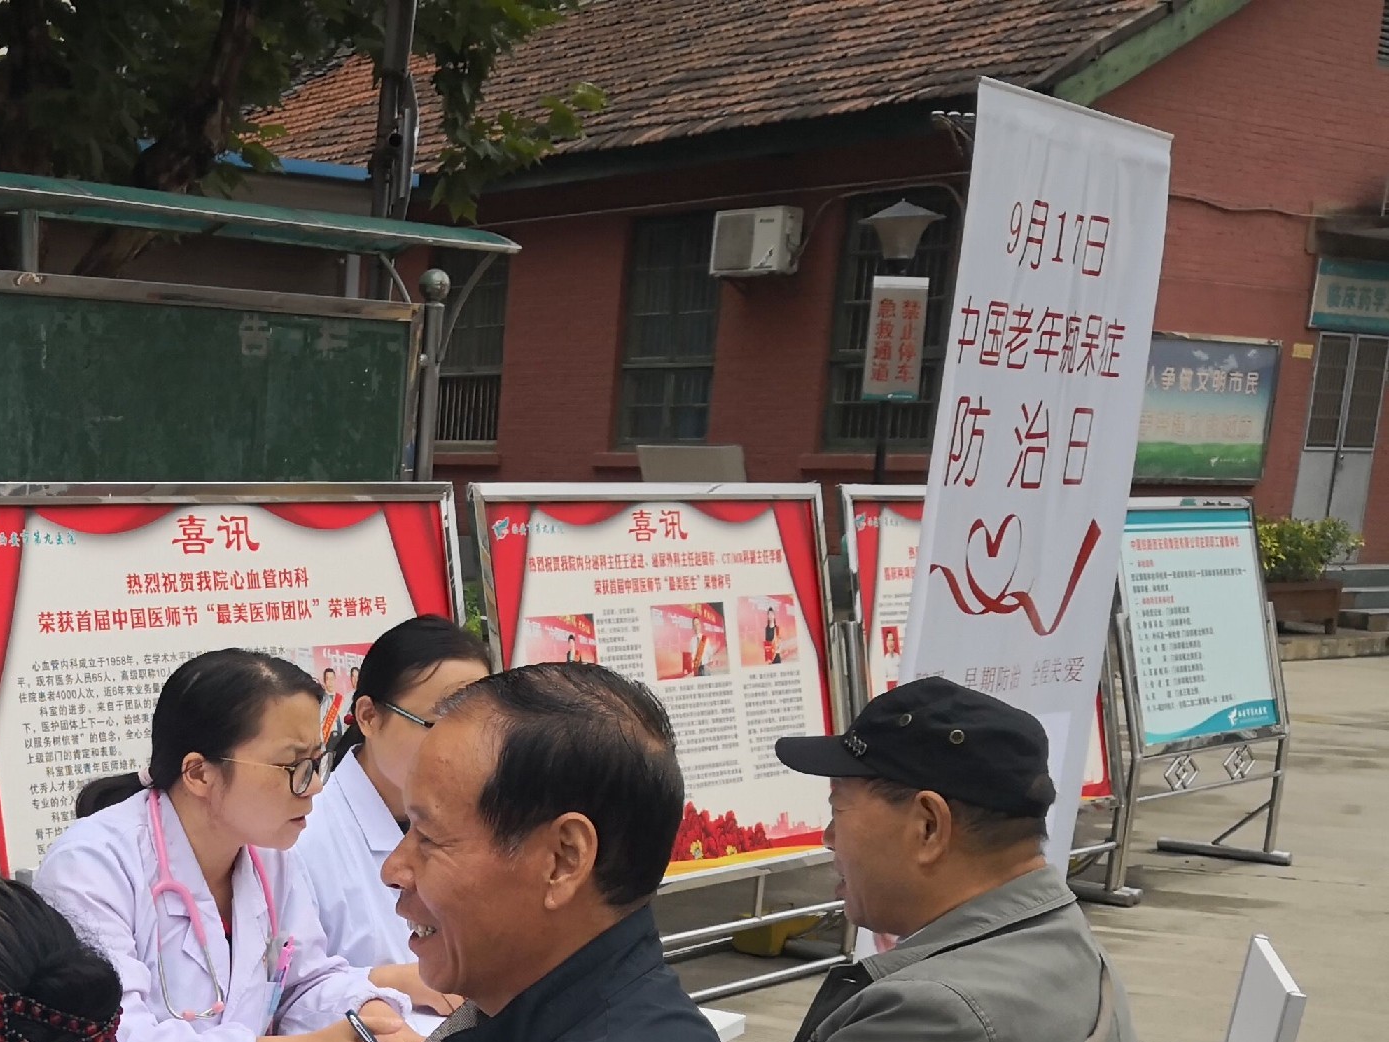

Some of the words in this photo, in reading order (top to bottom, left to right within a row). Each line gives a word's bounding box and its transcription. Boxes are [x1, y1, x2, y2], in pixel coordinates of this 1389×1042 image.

[1007, 199, 1110, 276] 9月17日
[957, 296, 1126, 378] 中国老年痴呆症
[943, 396, 1094, 488] 防治日
[172, 514, 260, 554] 喜讯
[628, 509, 689, 543] 喜讯
[126, 567, 309, 594] 热烈祝贺我院心血管内科
[38, 596, 387, 634] 荣获首届中国医师节“最美医师团队”荣誉称号
